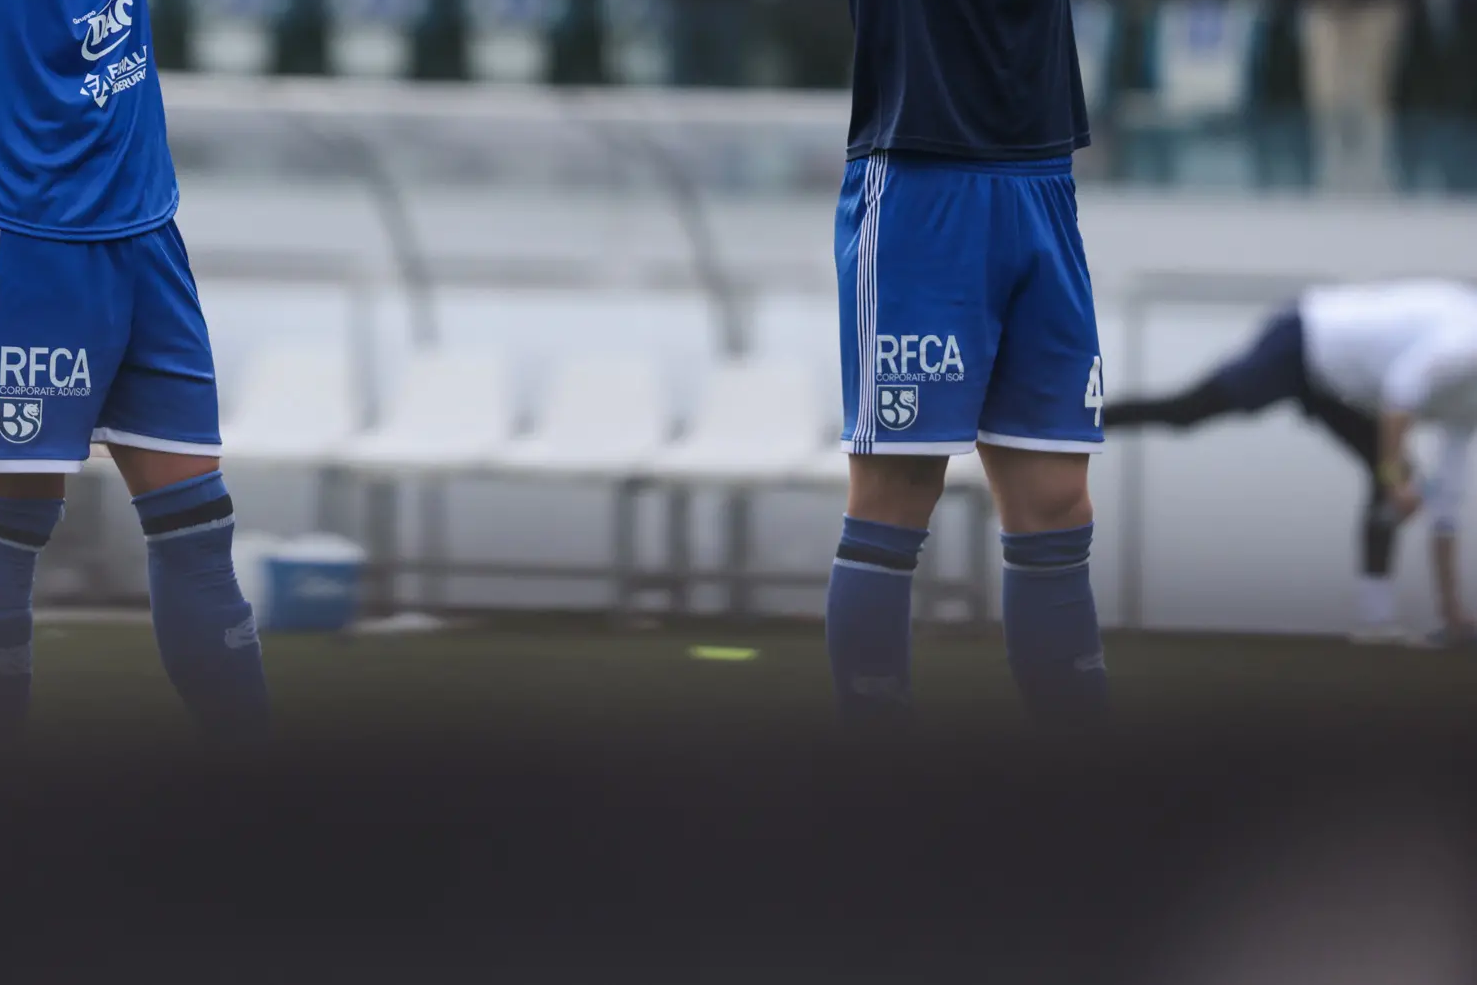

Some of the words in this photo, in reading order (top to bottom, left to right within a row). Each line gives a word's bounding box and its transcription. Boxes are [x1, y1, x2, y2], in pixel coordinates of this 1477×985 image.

[0, 346, 92, 388] RFCA
[876, 335, 965, 374] RFCA
[0, 385, 55, 396] CORPORATE
[57, 387, 92, 396] ADVISOR
[876, 373, 926, 382] CORPORATE
[1084, 355, 1104, 427] 4
